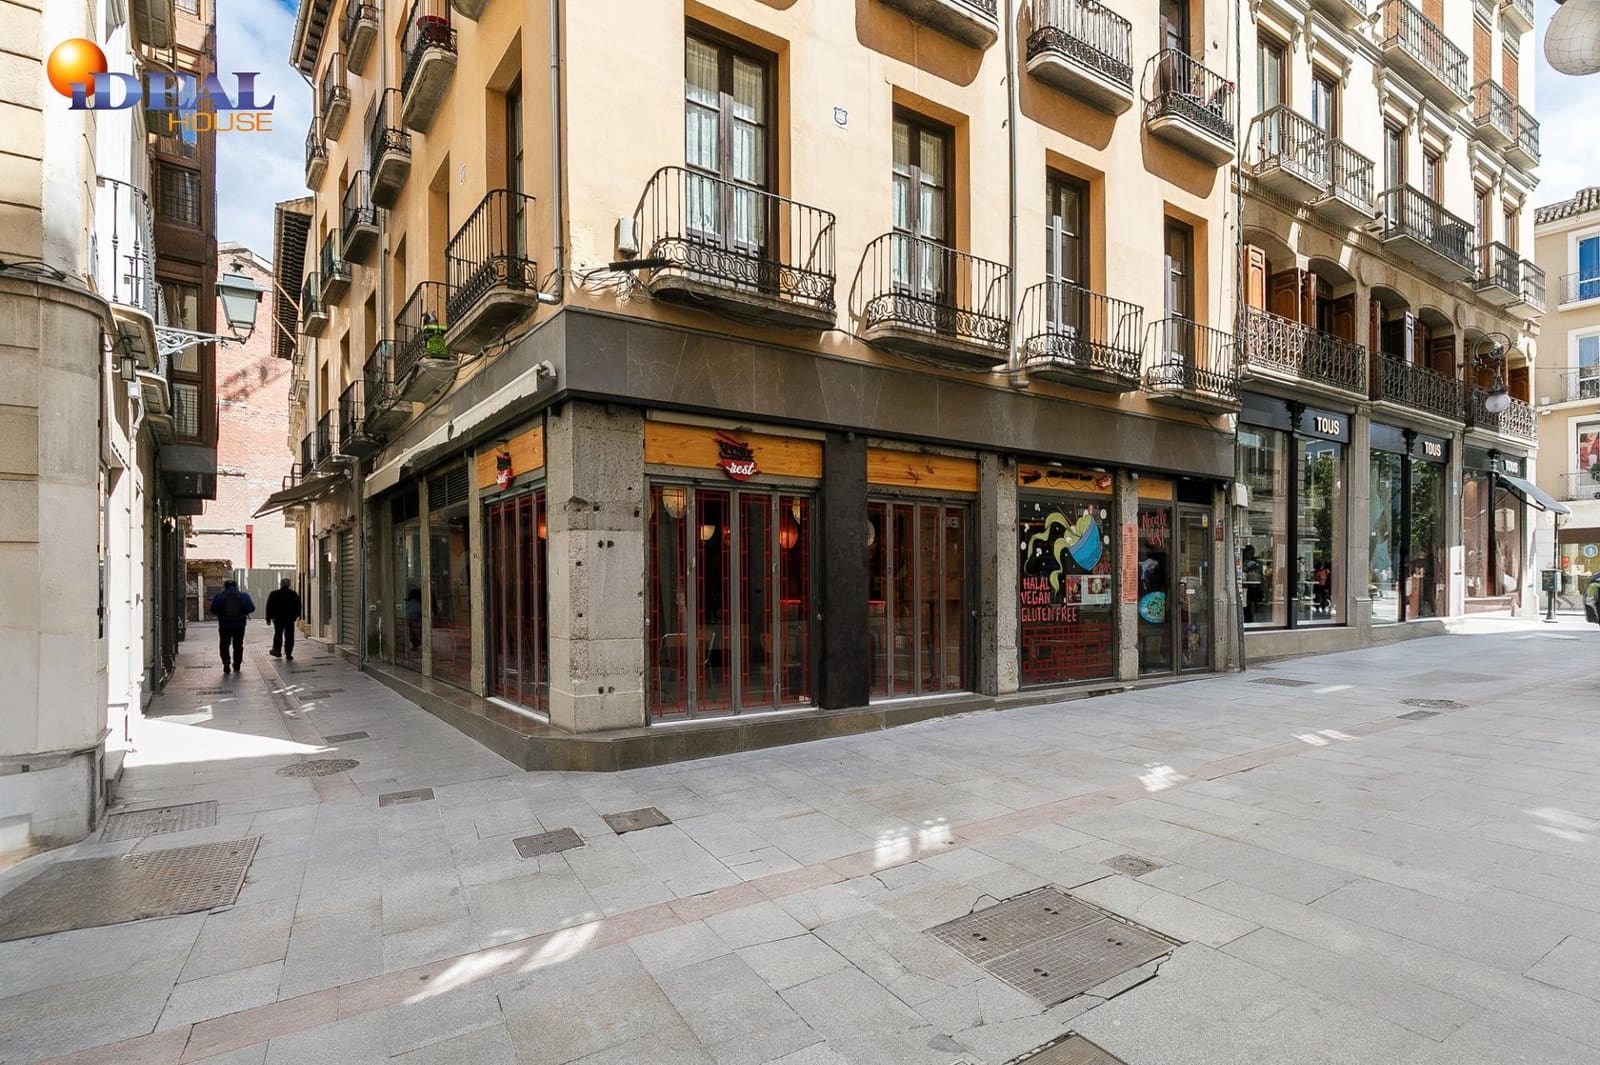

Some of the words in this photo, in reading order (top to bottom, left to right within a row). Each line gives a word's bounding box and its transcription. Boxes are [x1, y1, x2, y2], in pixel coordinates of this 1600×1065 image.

[1316, 416, 1340, 436] TOUS
[1424, 441, 1441, 457] TOUS
[1023, 577, 1050, 591] HALAL
[1020, 591, 1051, 605] VEGAN
[1021, 607, 1053, 622] GLUTEN
[1055, 606, 1077, 622] FREE
